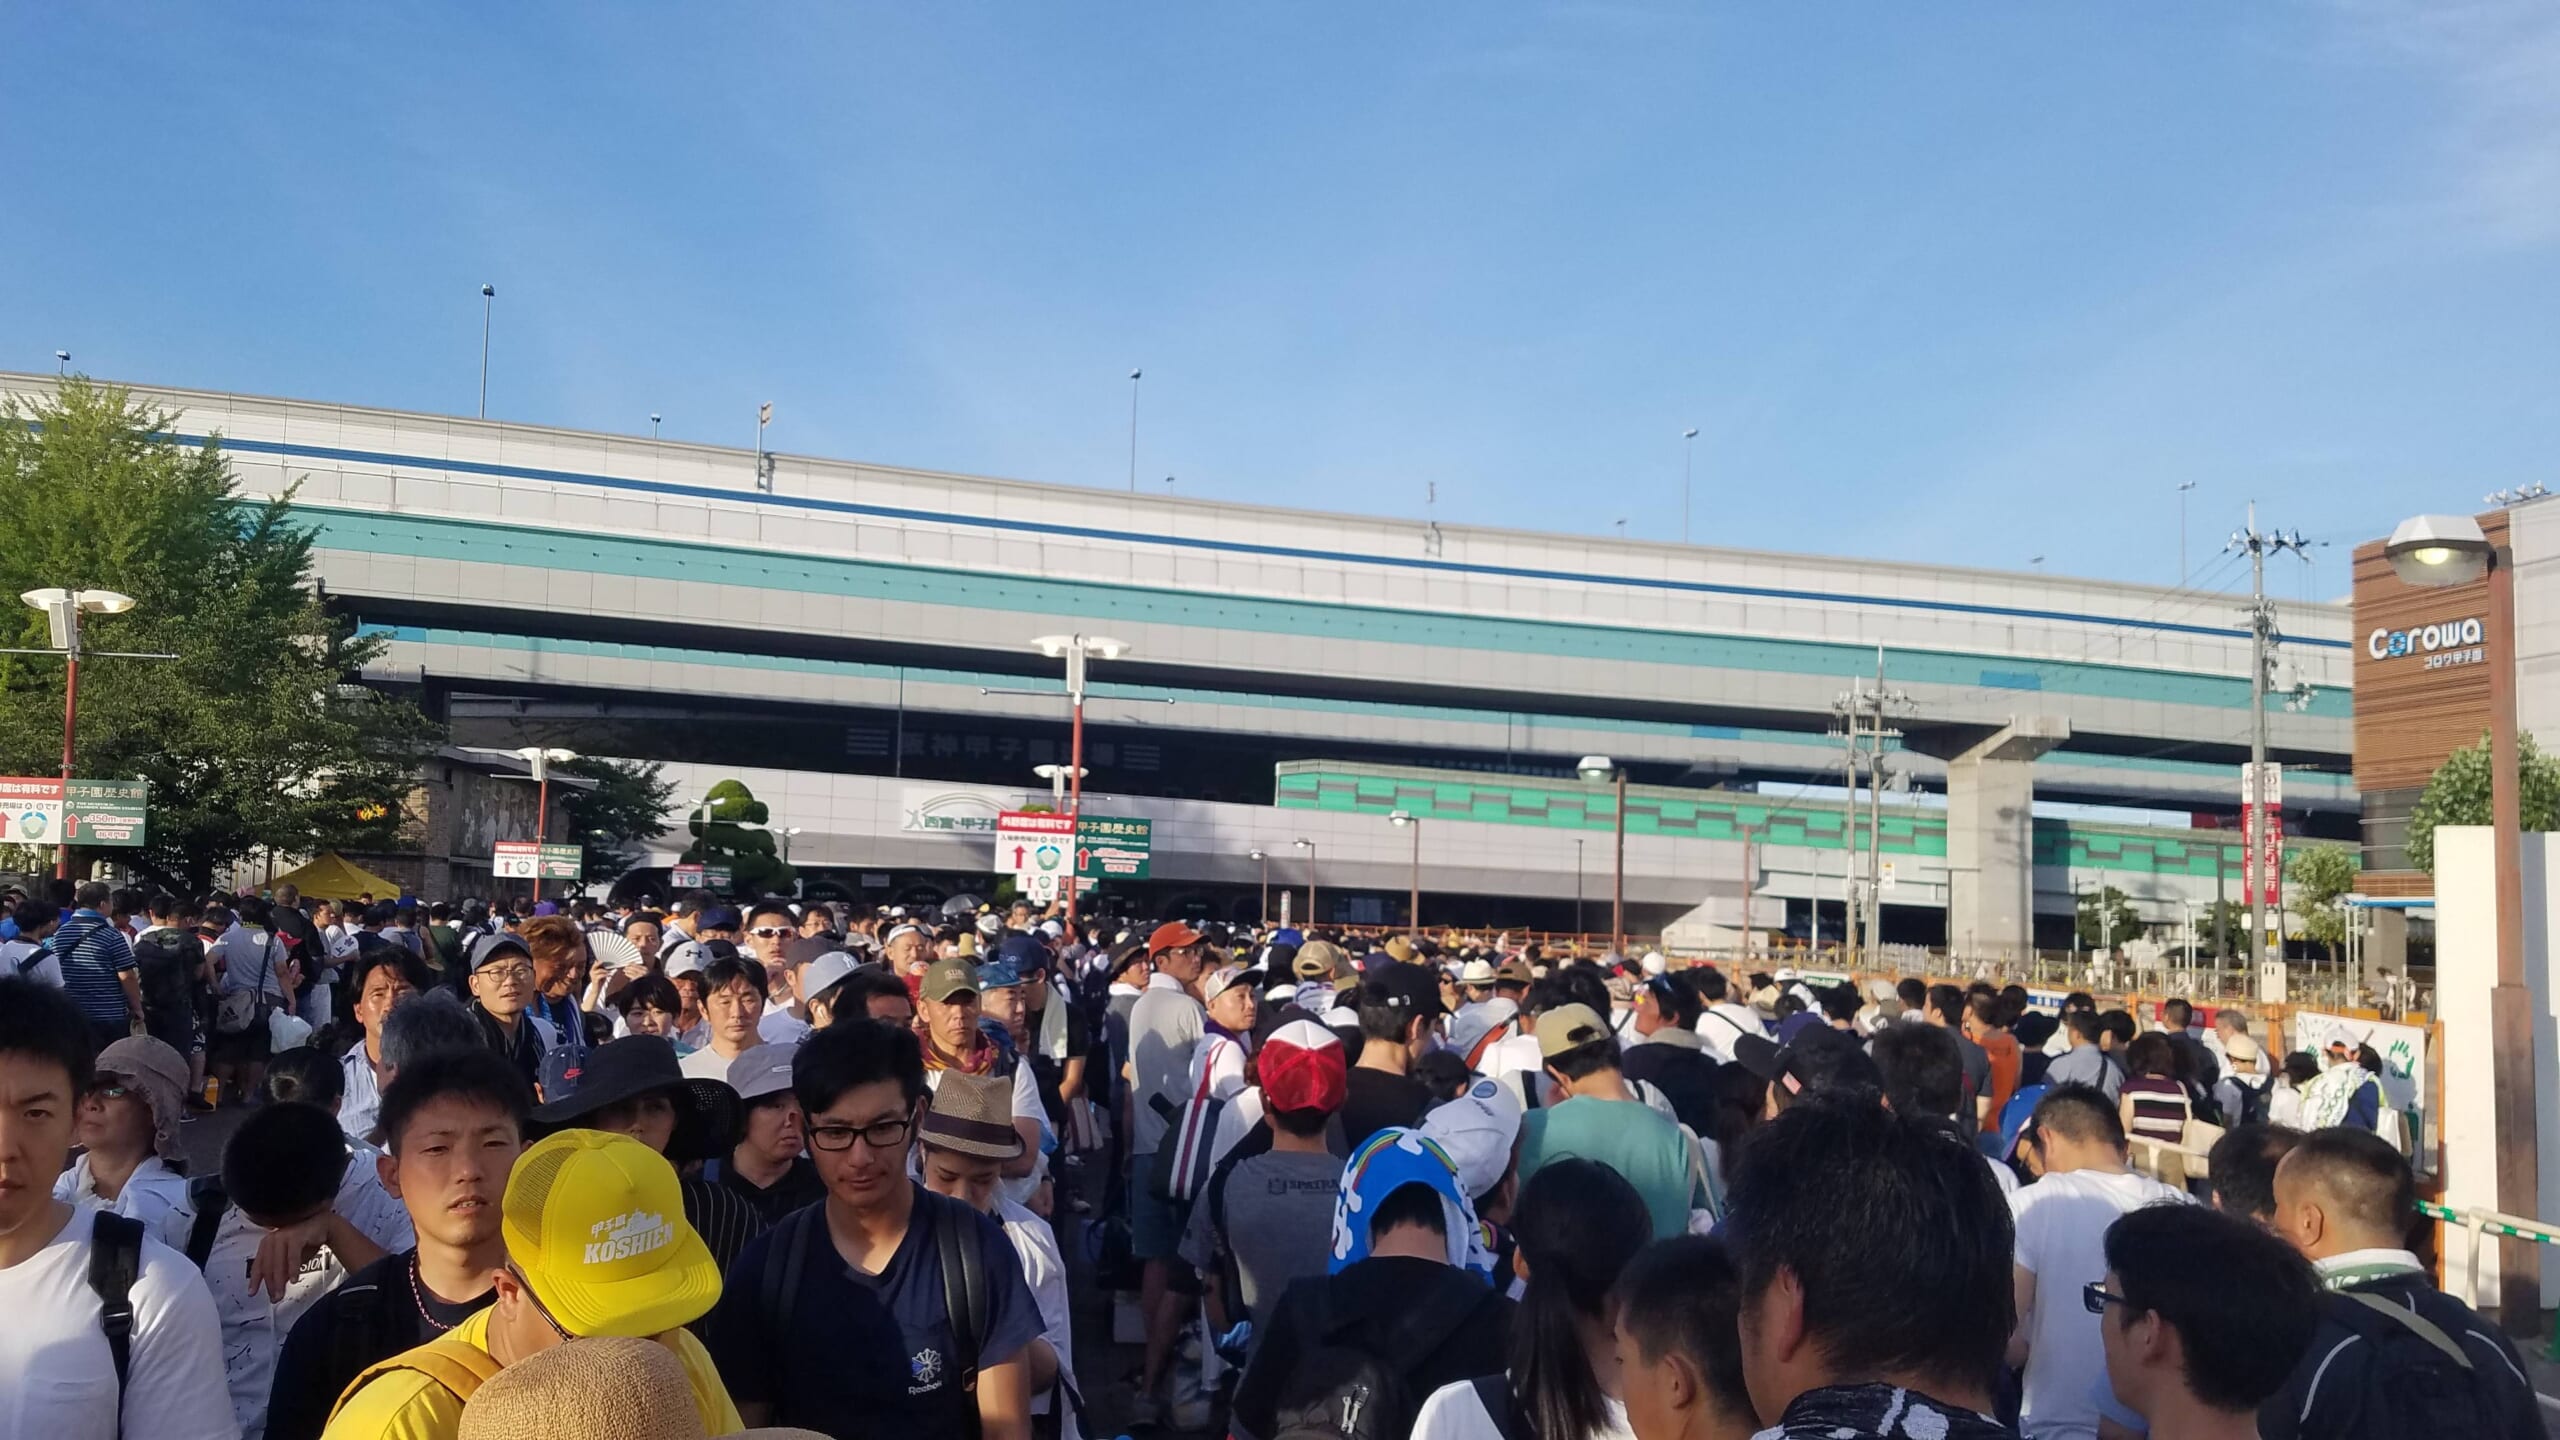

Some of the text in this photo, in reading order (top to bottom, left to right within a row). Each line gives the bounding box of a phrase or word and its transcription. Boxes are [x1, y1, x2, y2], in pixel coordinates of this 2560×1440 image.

[2368, 618, 2483, 660] Corowa
[0, 783, 60, 795] 席は有料です
[66, 786, 144, 799] 甲子園歴史館
[583, 1222, 673, 1265] KOSHIEN
[908, 1380, 942, 1395] Reebok
